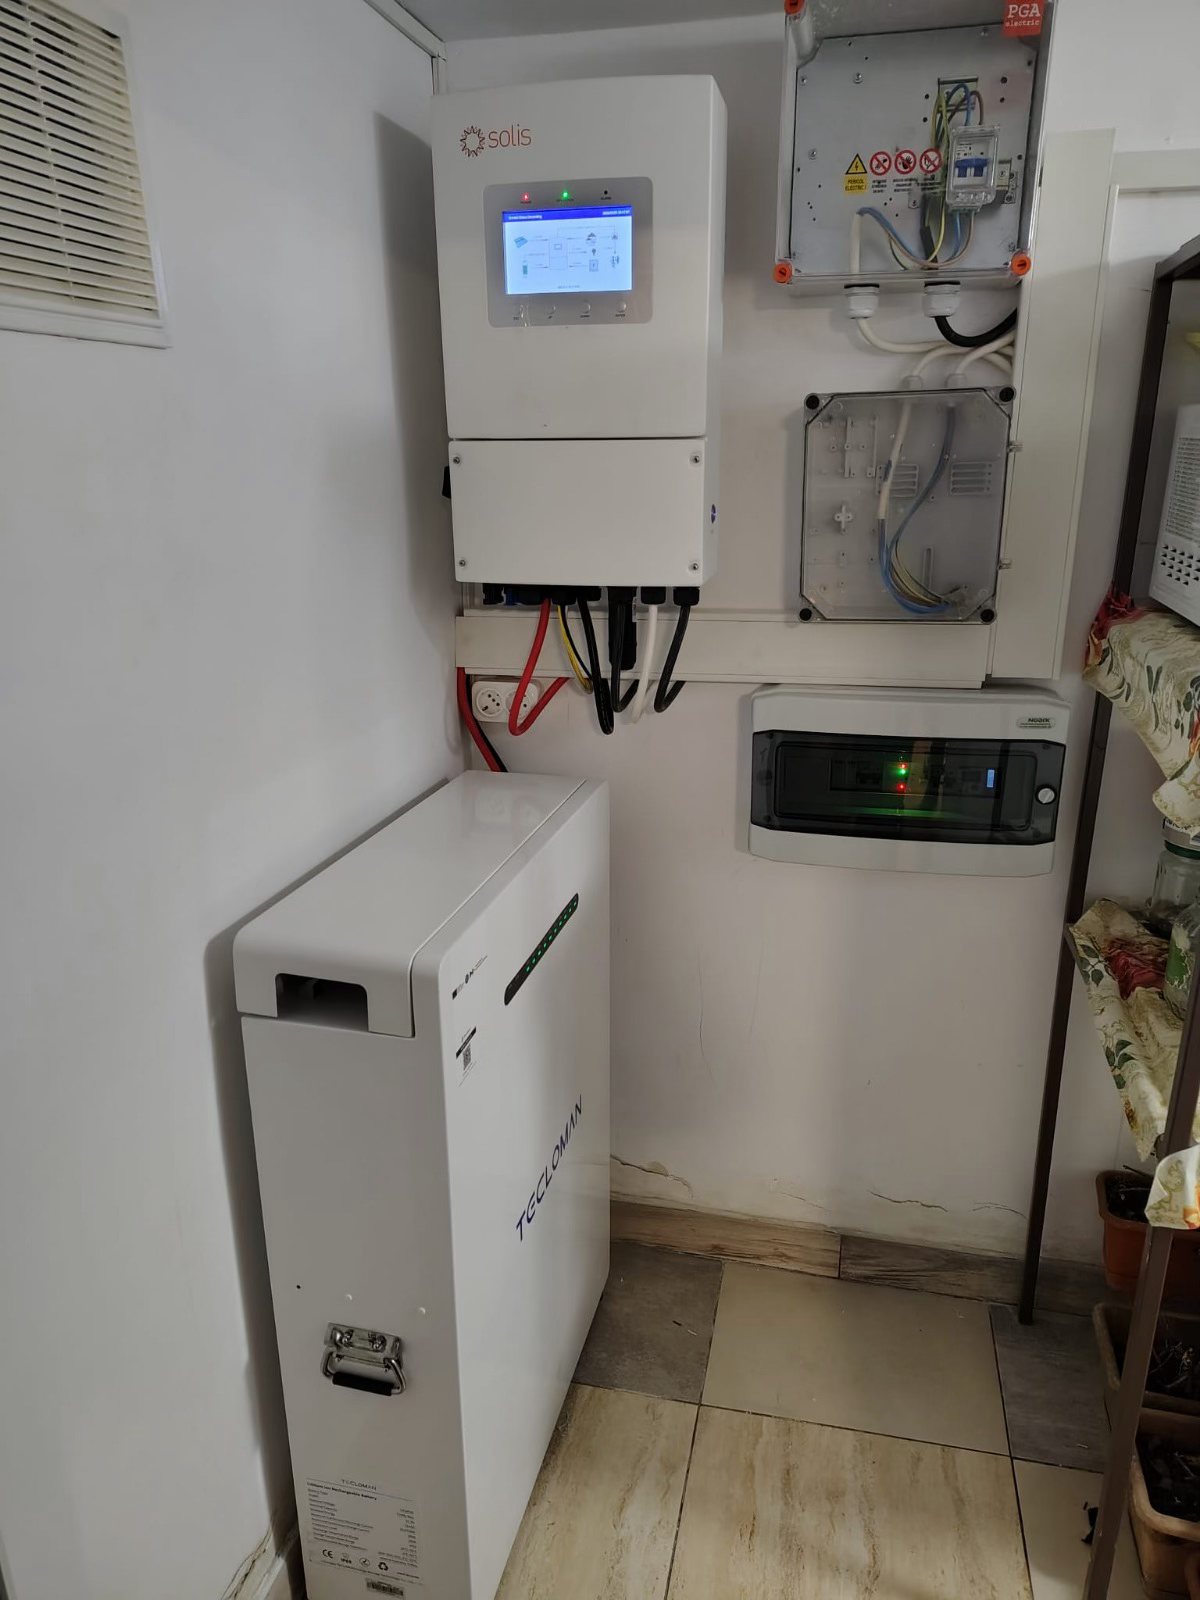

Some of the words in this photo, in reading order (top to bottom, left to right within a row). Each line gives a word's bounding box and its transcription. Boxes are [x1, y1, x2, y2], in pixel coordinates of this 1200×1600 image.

[1007, 3, 1041, 18] PGA
[1005, 19, 1040, 27] electric
[488, 123, 532, 149] solis
[516, 1094, 582, 1242] TECLOMAN
